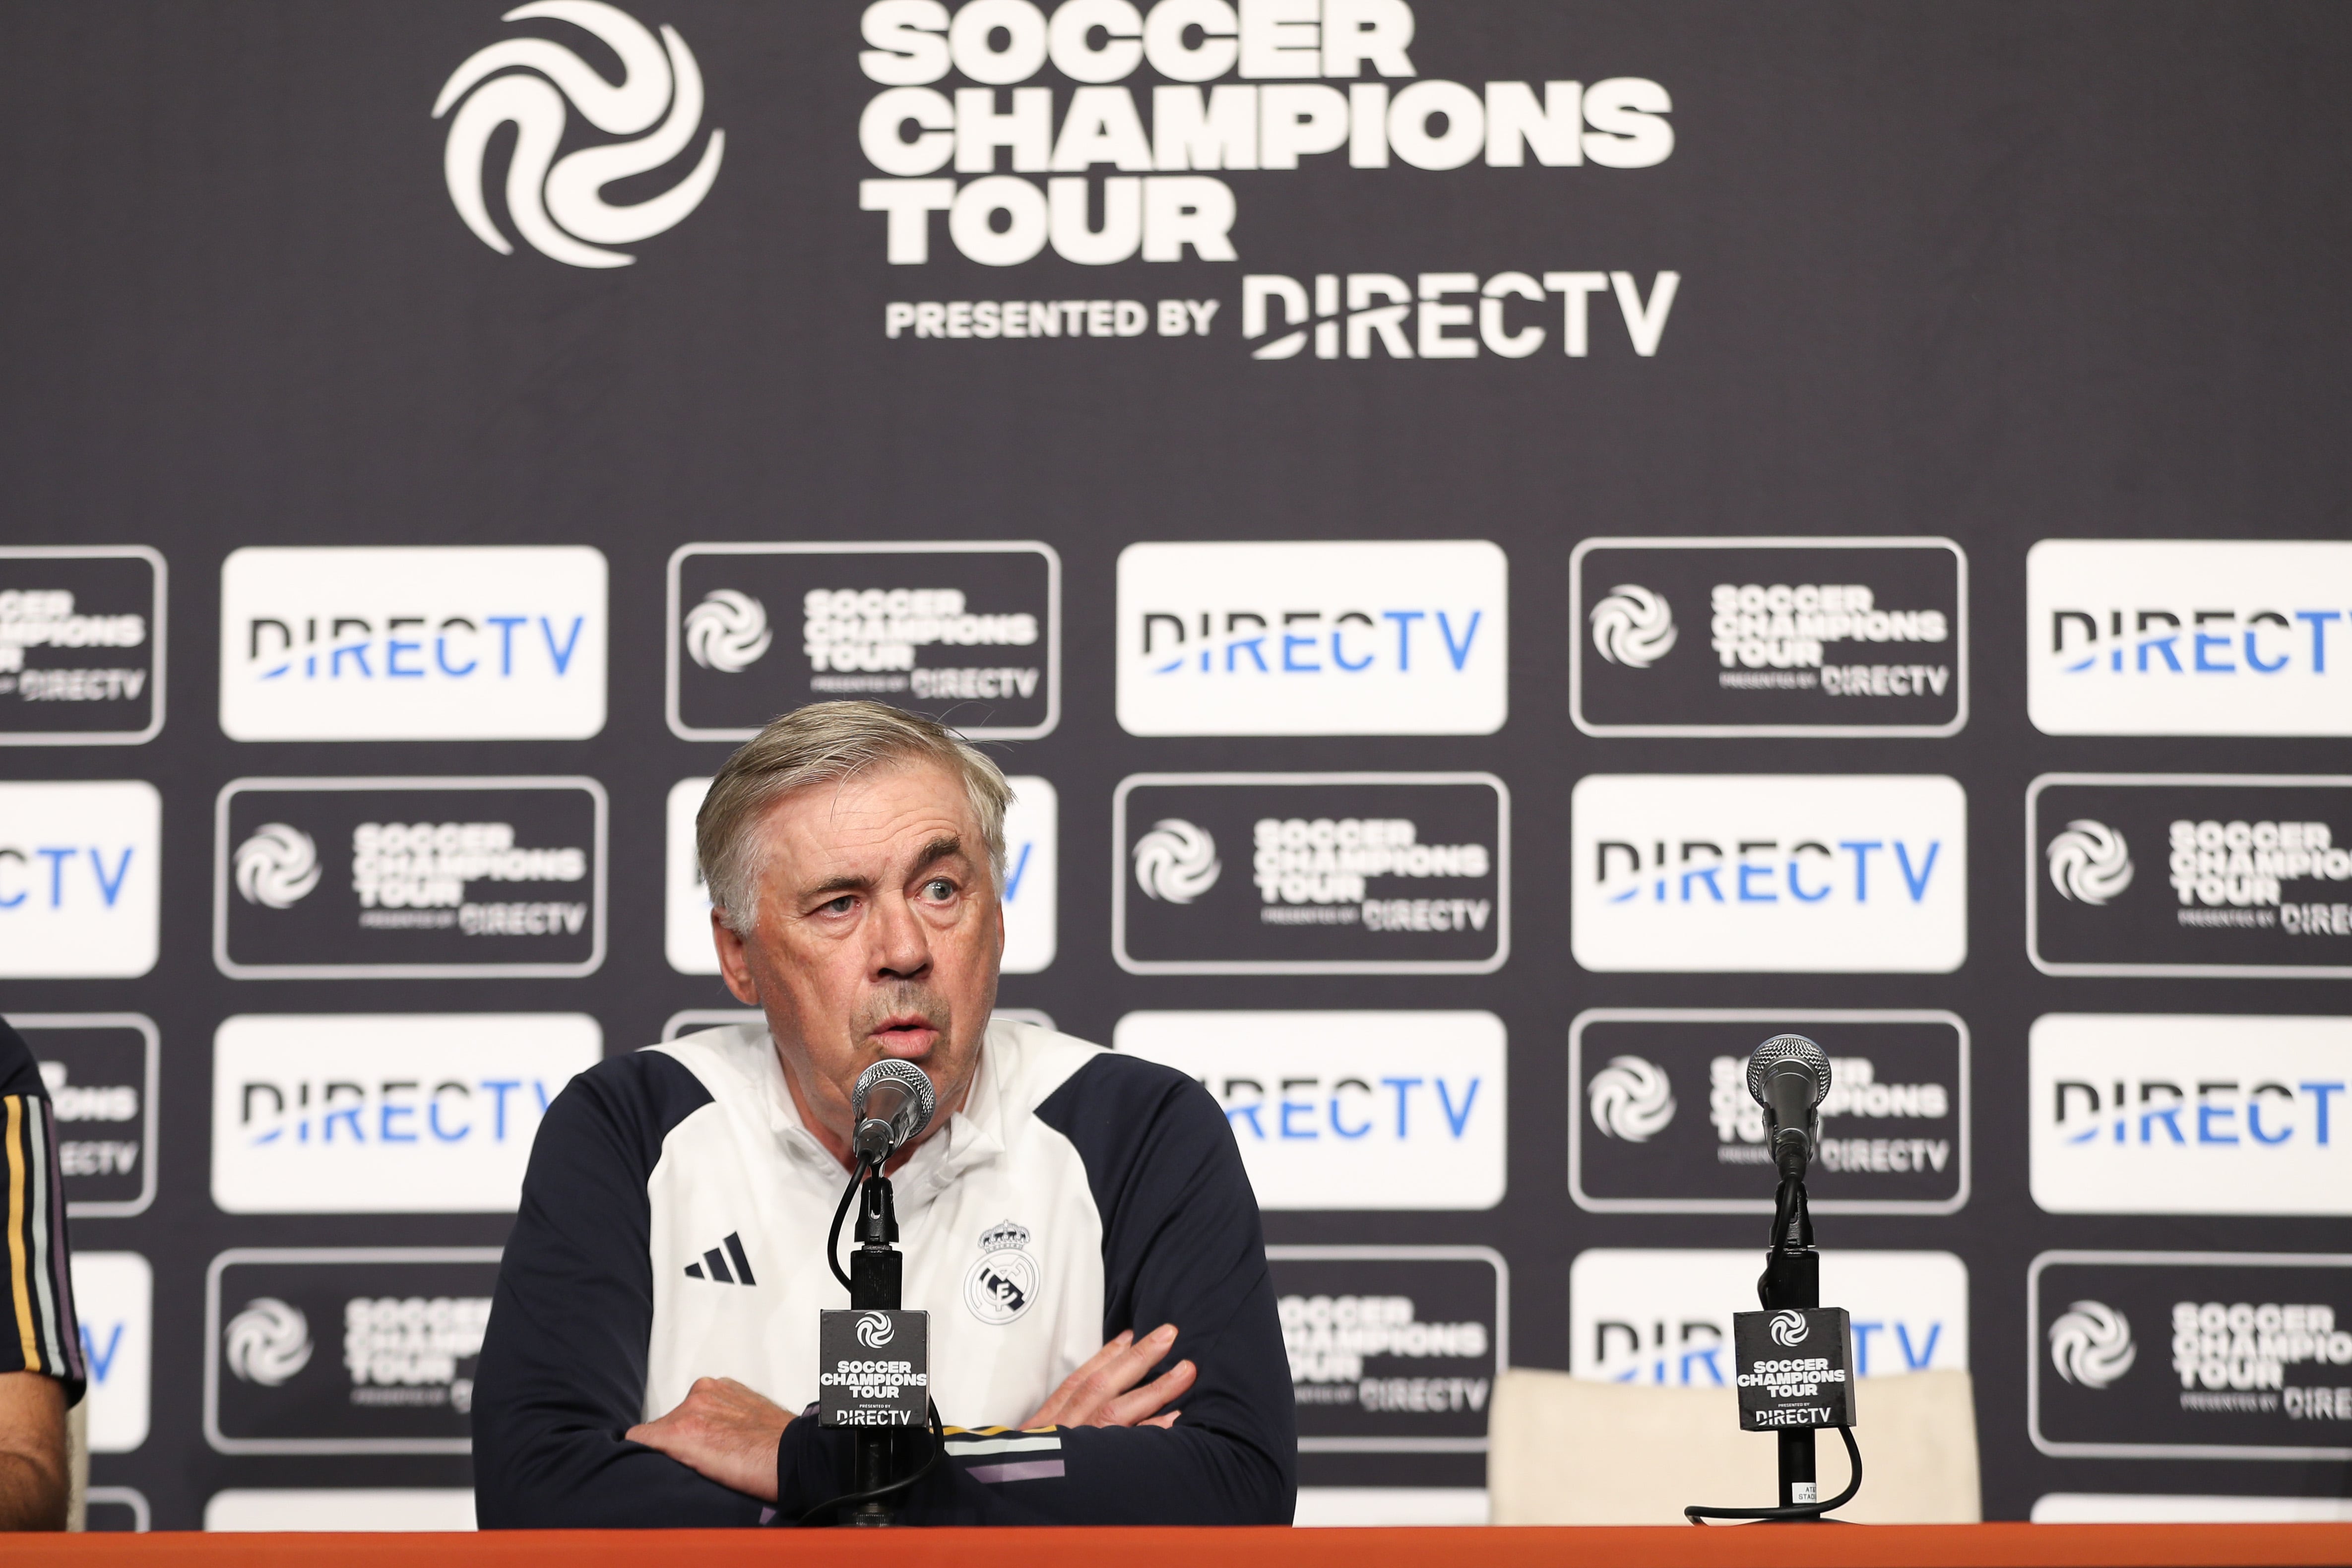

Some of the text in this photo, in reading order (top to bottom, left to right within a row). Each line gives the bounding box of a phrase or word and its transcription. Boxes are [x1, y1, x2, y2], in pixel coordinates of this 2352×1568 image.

[859, 0, 1416, 85] SOCCER
[859, 76, 1675, 176] CHAMPIONS
[859, 176, 1238, 266] TOUR
[886, 271, 1680, 360] PRESENTED BY DIRECTV
[804, 589, 965, 617] SOCCER
[1711, 584, 1874, 613] SOCCER
[804, 615, 1037, 645] CHAMPIONS
[1711, 610, 1947, 642] CHAMPIONS
[249, 616, 583, 678] DIRECTV
[1143, 611, 1481, 673] DIRECTV
[1711, 639, 1823, 668] TOUR
[2052, 610, 2352, 673] DIRECT
[804, 644, 915, 671] TOUR
[911, 669, 1038, 698] DIRECTV
[1821, 666, 1948, 695] DIRECTV
[354, 823, 513, 850] SOCCER
[1254, 818, 1415, 847] SOCCER
[2169, 820, 2331, 849] SOCCER
[353, 849, 585, 880] CHAMPIONS
[1254, 845, 1489, 877] CHAMPIONS
[1596, 841, 1940, 903] DIRECTV
[353, 878, 463, 907] TOUR
[1254, 875, 1365, 903] TOUR
[2169, 877, 2280, 906] TOUR
[459, 905, 585, 935] DIRECTV
[1362, 900, 1489, 931] DIRECTV
[241, 1081, 552, 1146] DIRECT
[1821, 1140, 1948, 1171] DIRECTV
[821, 1373, 927, 1386] CHAMPIONS
[837, 1361, 911, 1374] SOCCER
[1737, 1369, 1845, 1387] CHAMPIONS
[1753, 1358, 1829, 1374] SOCCER
[849, 1386, 899, 1398] TOUR
[1767, 1383, 1818, 1398] TOUR
[837, 1410, 911, 1425] DIRECTV
[1756, 1407, 1832, 1426] DIRECTV
